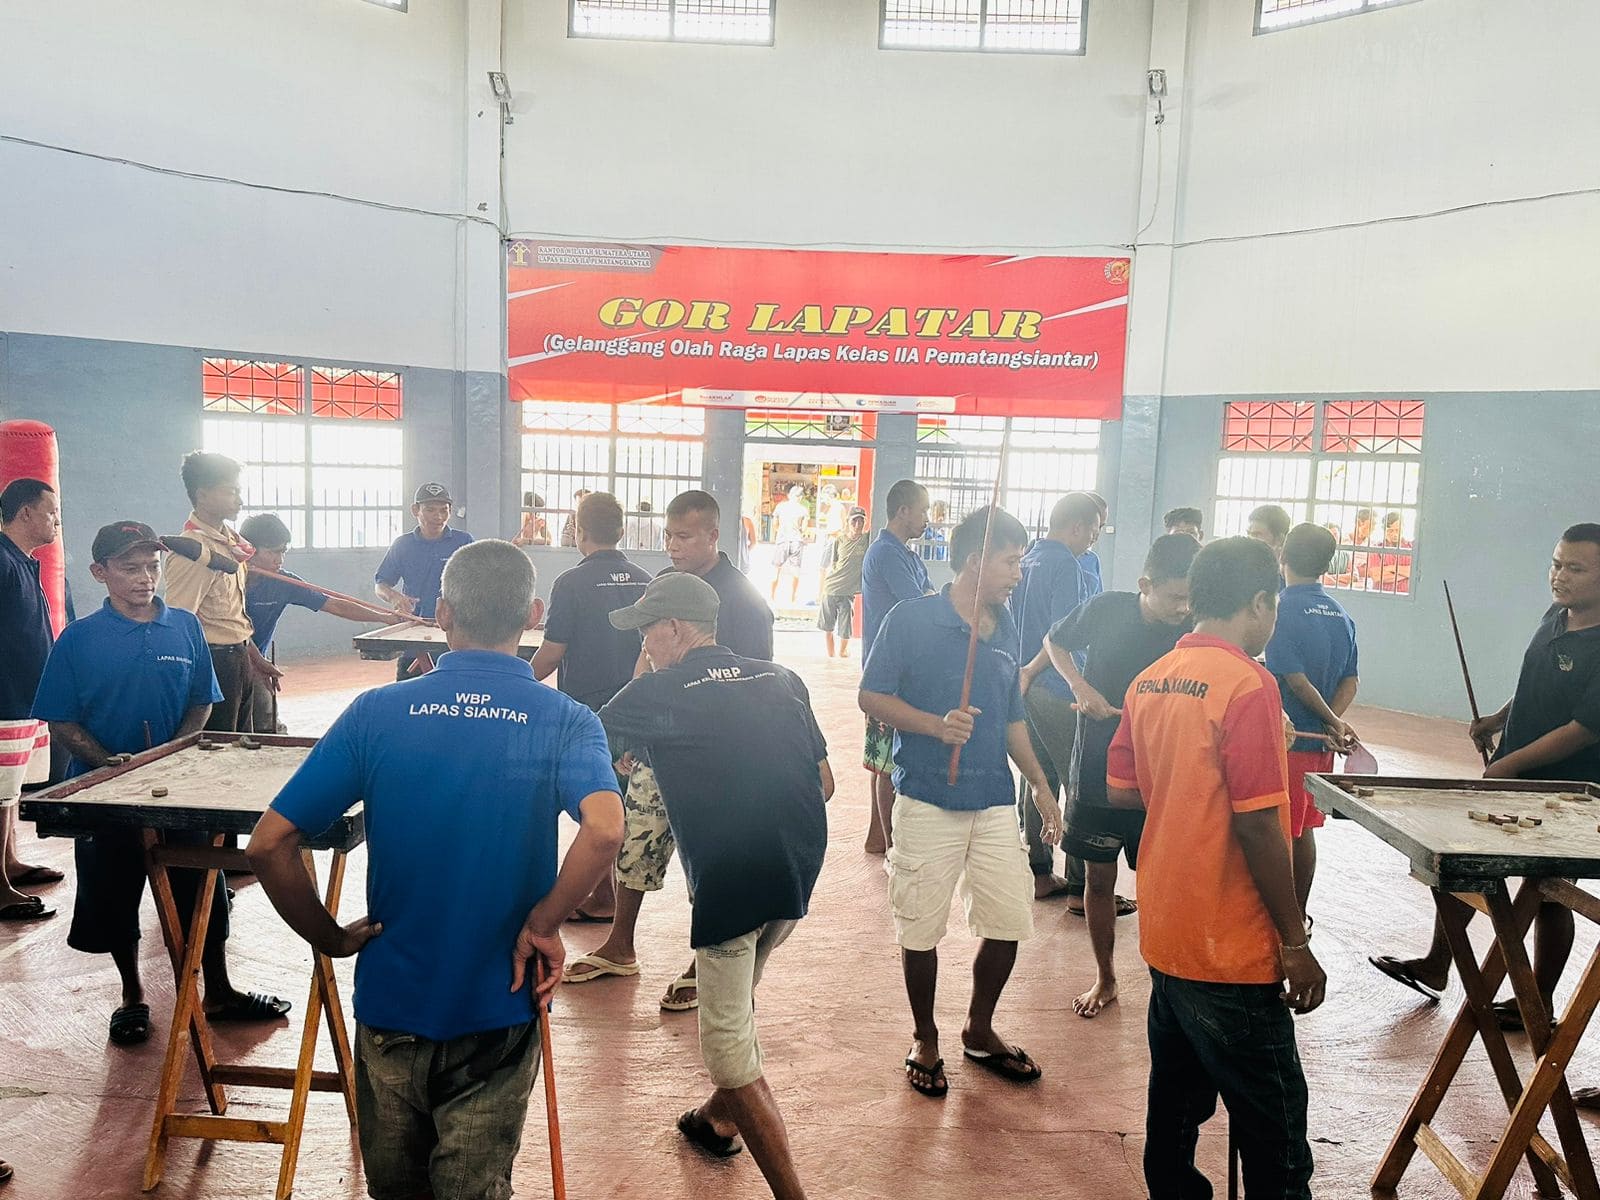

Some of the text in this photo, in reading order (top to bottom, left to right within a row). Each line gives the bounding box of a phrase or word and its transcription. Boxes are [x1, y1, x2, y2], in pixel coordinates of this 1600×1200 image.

[538, 246, 650, 259] KANTOR WILAYAH SUMATERA UTARA
[538, 255, 559, 264] LAPAS
[559, 256, 580, 265] KELAS
[590, 257, 651, 267] PEMATANGSIANTAR
[598, 298, 1043, 340] GOR LAPATAR
[543, 333, 1099, 370] (Gelanggang Olah Raga Lapas Kelas IIA Pematangsiantar)
[610, 572, 631, 582] WBP
[707, 667, 741, 679] WBP
[455, 692, 492, 705] WBP
[409, 703, 528, 725] LAPAS SIANTAR
